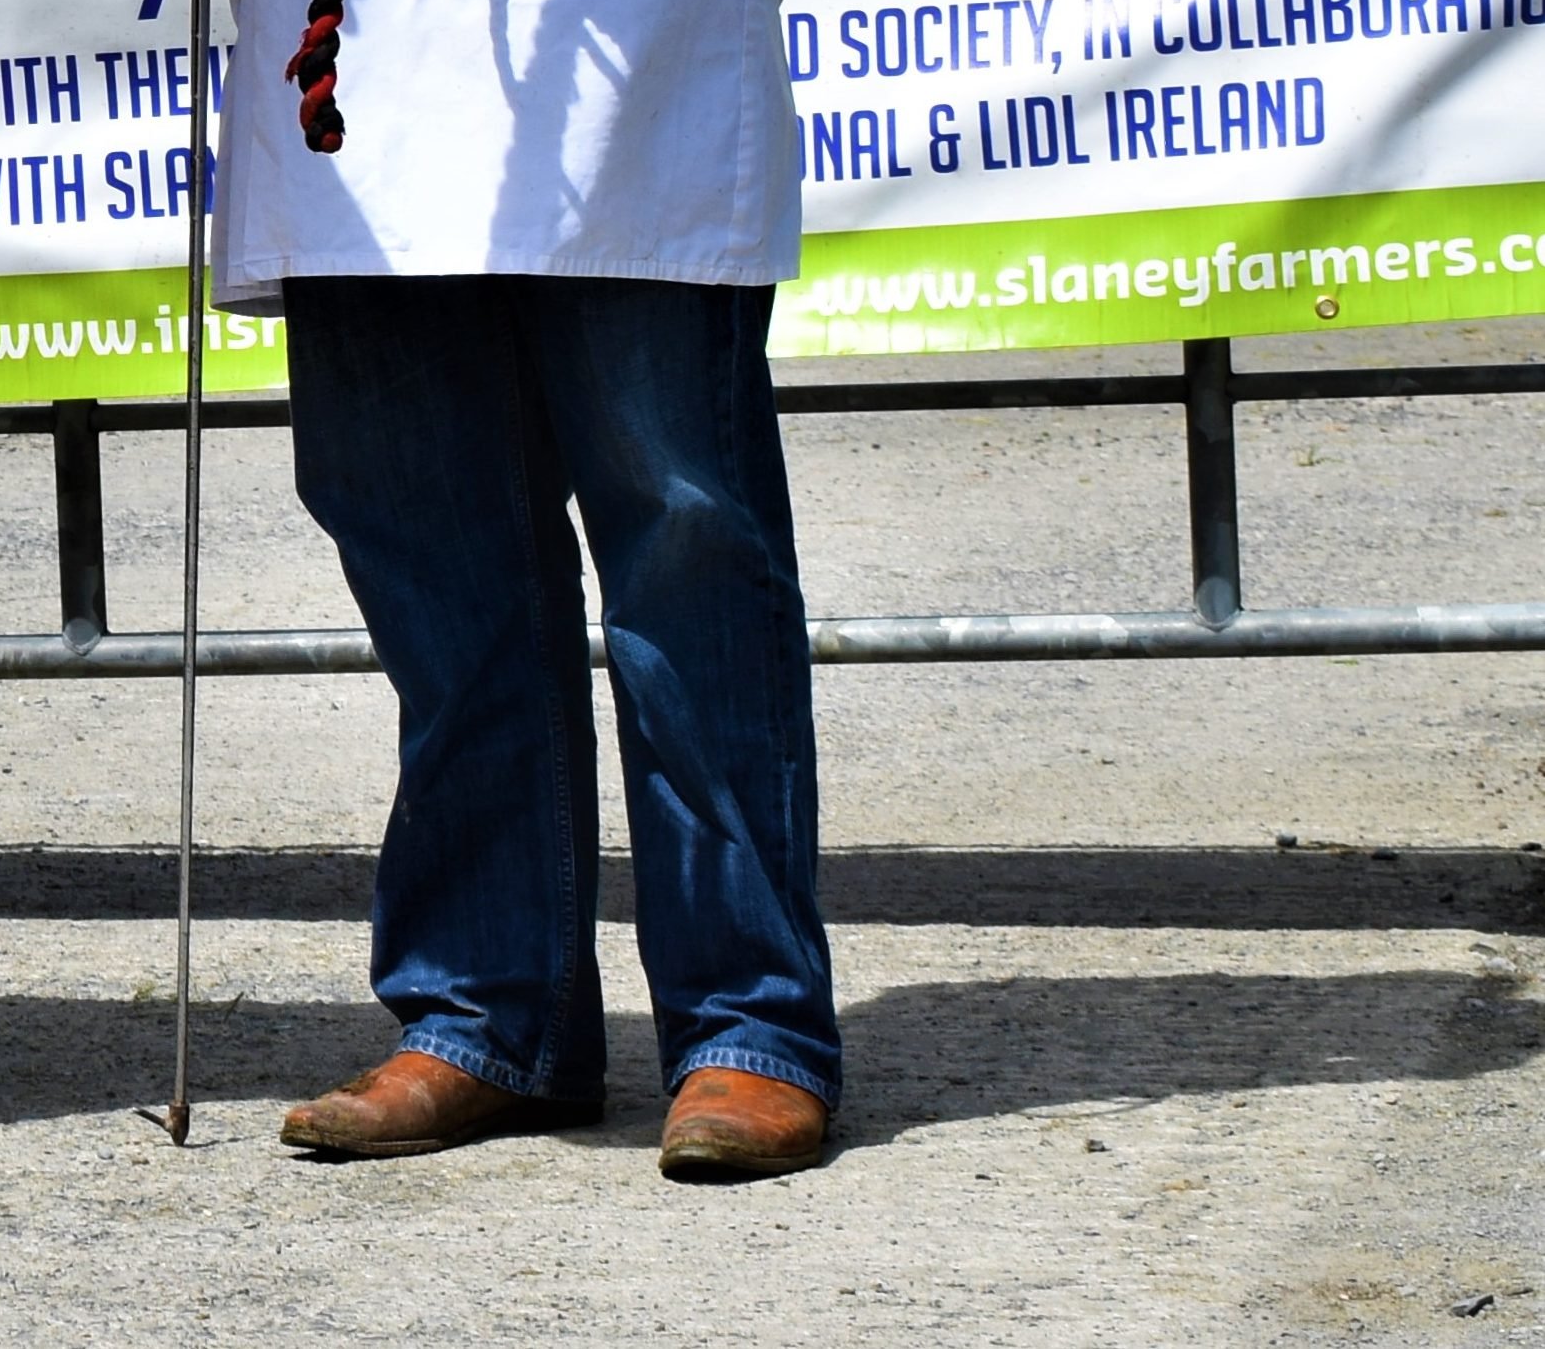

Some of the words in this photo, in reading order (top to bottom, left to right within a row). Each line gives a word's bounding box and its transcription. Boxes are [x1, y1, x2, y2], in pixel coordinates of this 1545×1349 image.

[94, 47, 193, 120] THE
[104, 146, 216, 220] SLA
[928, 103, 962, 174] &
[978, 94, 1091, 171] LIDL
[1107, 76, 1325, 163] IRELAND
[806, 233, 1545, 317] www.slaneyfarmers.c
